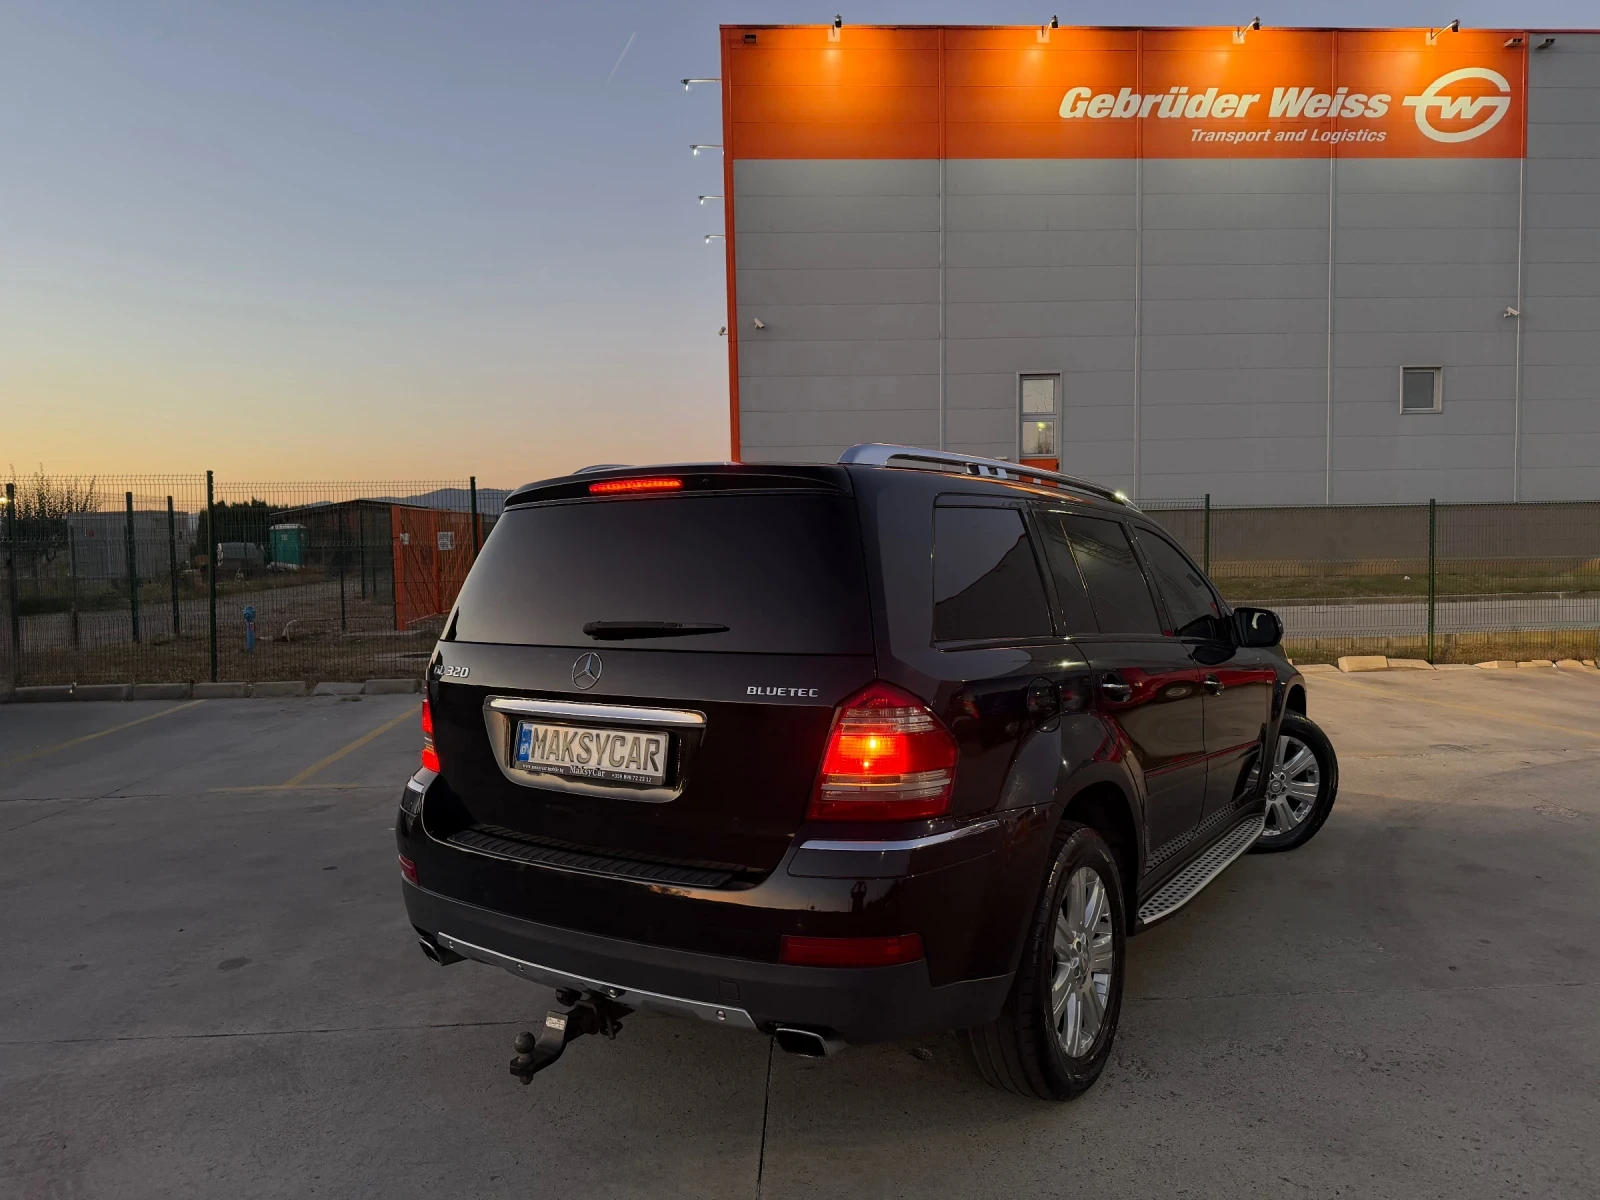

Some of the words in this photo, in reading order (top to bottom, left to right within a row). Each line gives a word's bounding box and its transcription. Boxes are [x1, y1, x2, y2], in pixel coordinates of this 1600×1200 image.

[1058, 86, 1261, 119] Gebrüder
[1268, 86, 1392, 118] Weiss
[1190, 128, 1271, 145] Transport
[1274, 128, 1308, 142] and
[1310, 128, 1387, 145] Logistics
[445, 665, 470, 678] 320
[746, 685, 819, 698] BLUETEC
[530, 727, 660, 772] MAKSYCAR
[569, 765, 606, 777] MaksyCar
